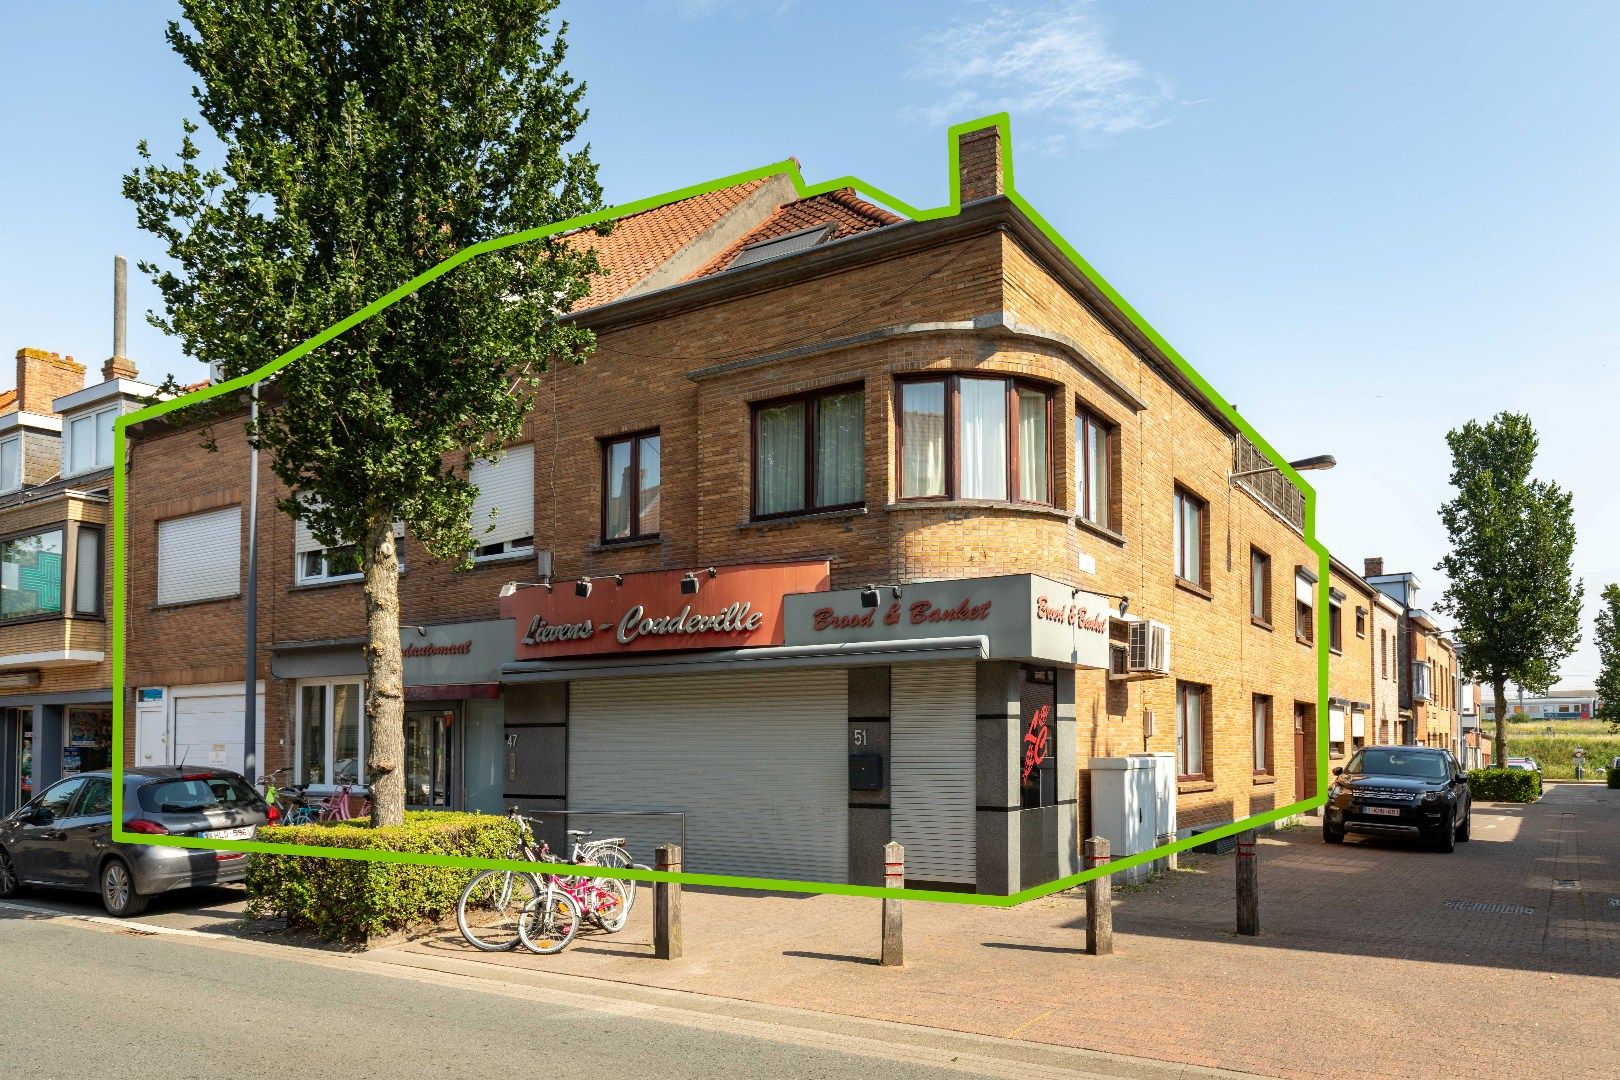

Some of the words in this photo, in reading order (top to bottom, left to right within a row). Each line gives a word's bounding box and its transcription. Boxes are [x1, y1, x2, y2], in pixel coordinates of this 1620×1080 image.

[521, 614, 594, 645] Lievens
[616, 601, 763, 644] Coudeville
[812, 606, 876, 631] Brood
[883, 602, 901, 625] &
[909, 598, 992, 625] Banket
[507, 734, 518, 748] 47
[854, 729, 867, 746] 51
